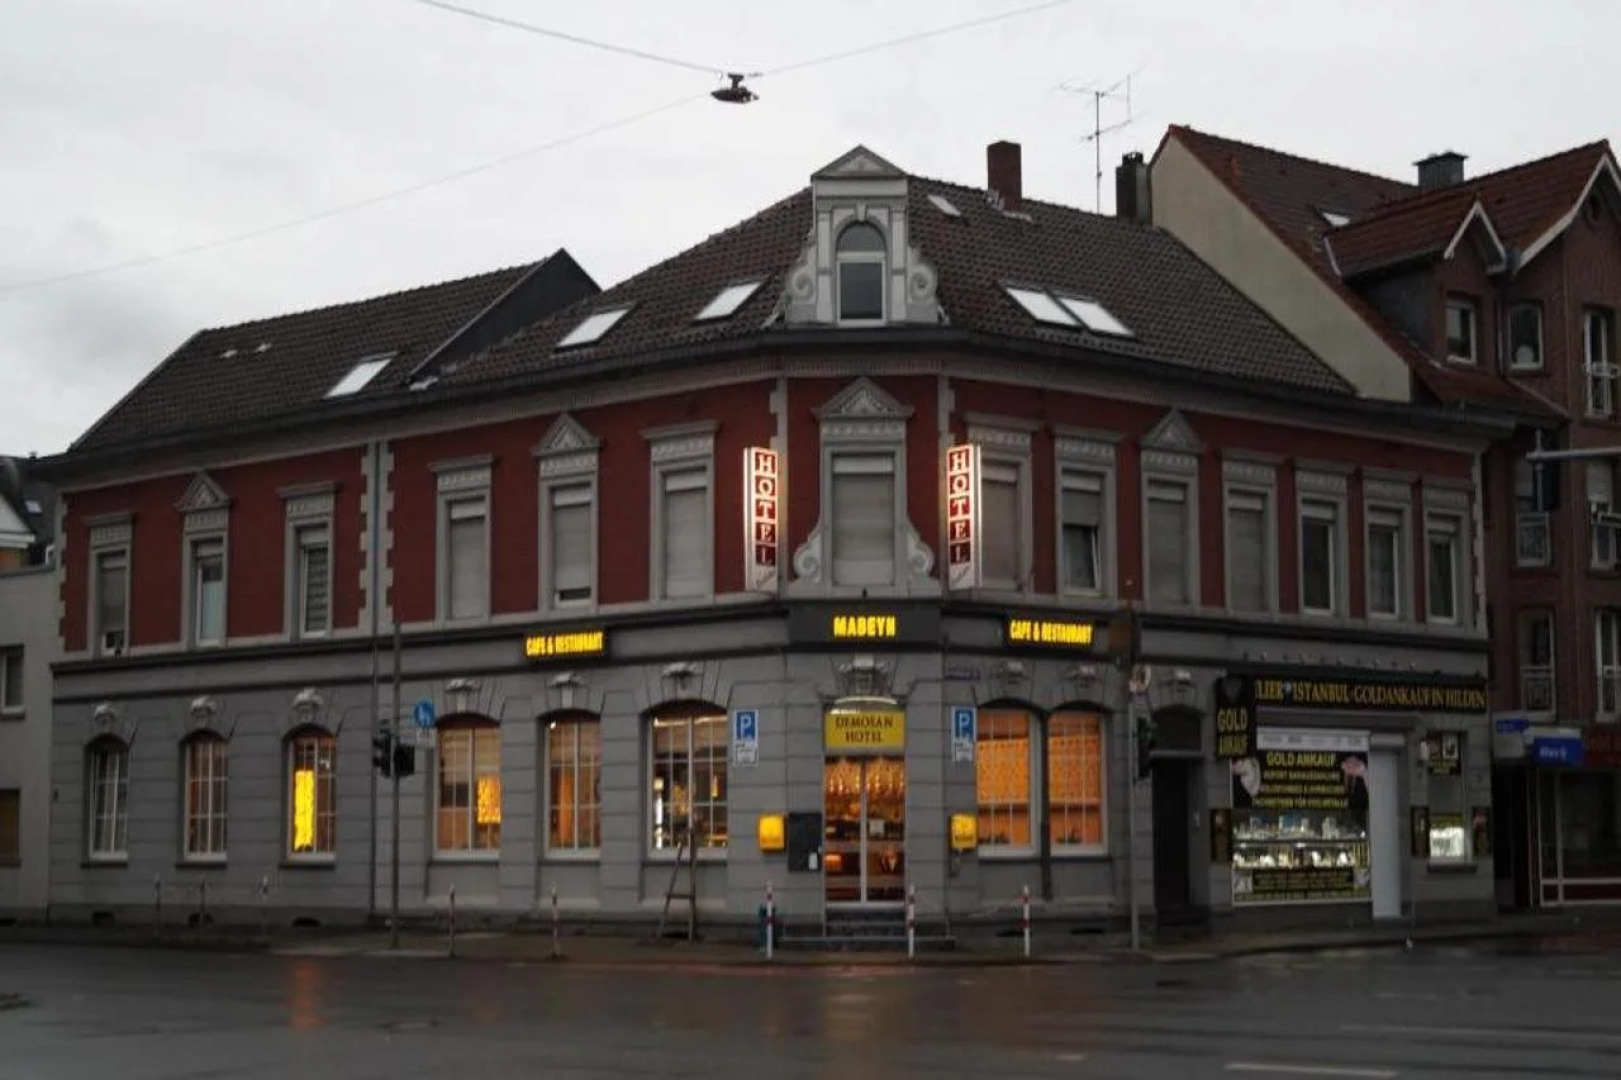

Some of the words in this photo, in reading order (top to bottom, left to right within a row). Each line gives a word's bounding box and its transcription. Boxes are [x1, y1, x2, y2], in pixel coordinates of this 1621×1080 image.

[758, 454, 775, 566] HOTEL
[952, 450, 971, 562] HOTEL
[740, 714, 752, 737] P
[835, 715, 893, 729] DEMOSAN
[959, 713, 970, 737] P
[1217, 708, 1247, 733] GOLD
[845, 730, 883, 743] HOTEL
[1266, 751, 1294, 766] GOLD
